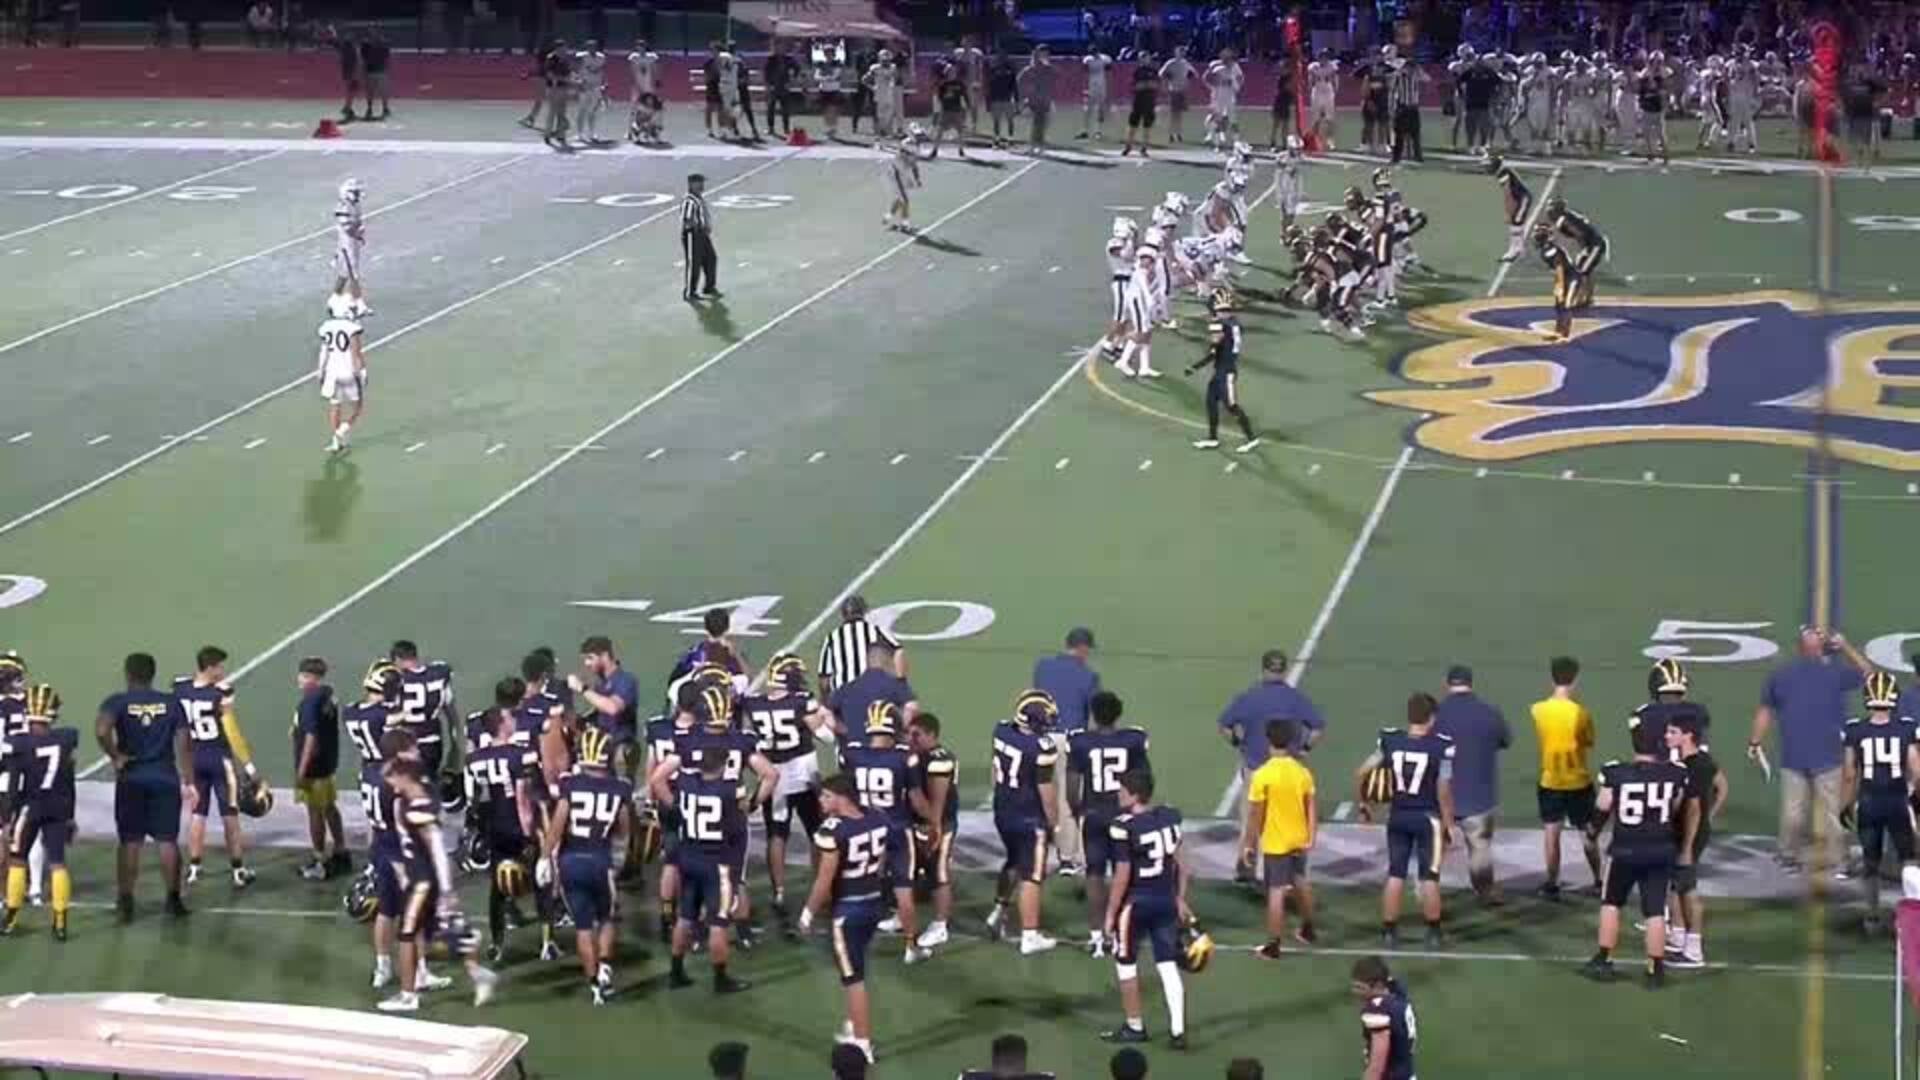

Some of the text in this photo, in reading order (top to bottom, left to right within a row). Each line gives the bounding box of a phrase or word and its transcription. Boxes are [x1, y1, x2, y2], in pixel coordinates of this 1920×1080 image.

[321, 330, 350, 352] 20
[402, 679, 446, 722] 27
[346, 719, 383, 760] 51
[752, 709, 800, 750] 35
[35, 744, 60, 790] 7
[1089, 747, 1128, 793] 12
[1391, 750, 1429, 795] 17
[1860, 736, 1902, 779] 14
[570, 790, 621, 838] 24
[679, 789, 723, 841] 42
[1618, 782, 1675, 825] 64
[842, 825, 888, 879] 55
[1139, 824, 1182, 878] 34
